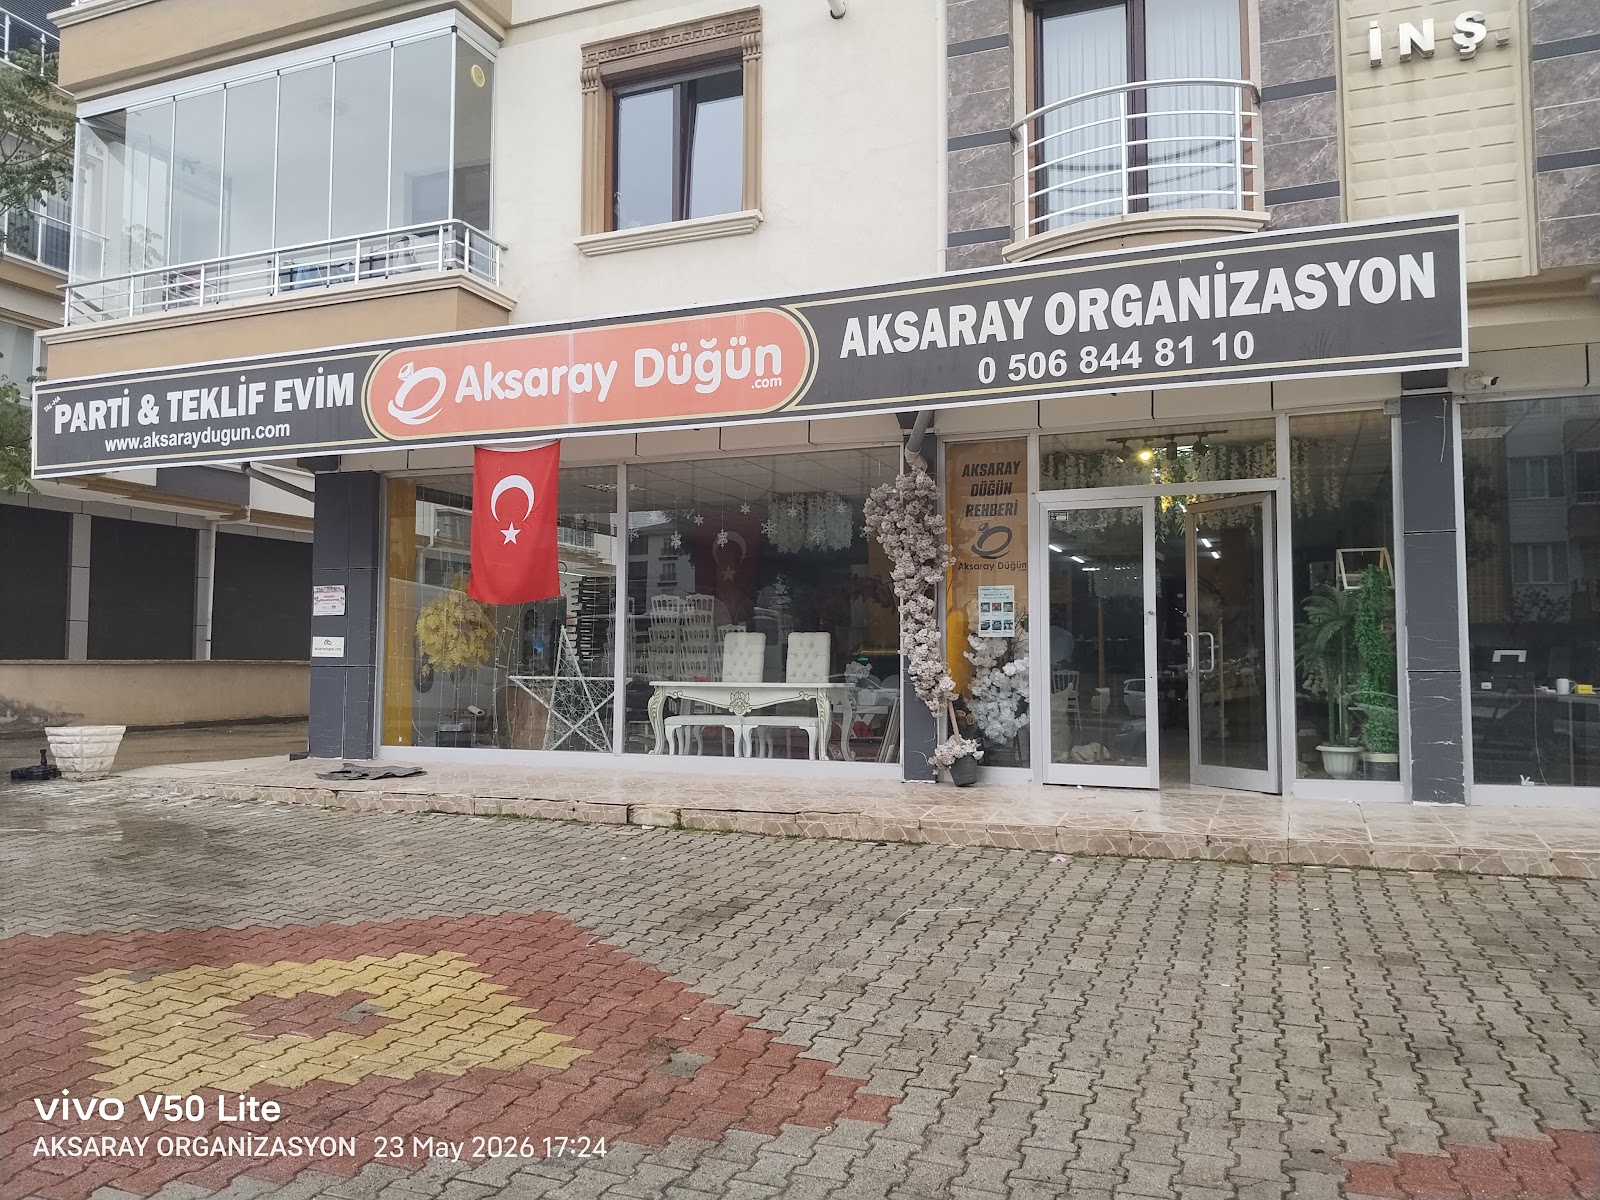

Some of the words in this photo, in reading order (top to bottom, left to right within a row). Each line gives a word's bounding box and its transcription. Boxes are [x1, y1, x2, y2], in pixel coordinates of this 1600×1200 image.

[839, 296, 1033, 359] AKSARAY
[1044, 251, 1436, 336] ORGANİZASYON
[978, 355, 996, 385] 0
[1007, 349, 1068, 382] 506
[1079, 341, 1143, 373] 844
[1155, 336, 1193, 367] 81
[1211, 330, 1255, 362] 10
[455, 361, 618, 404] Aksaray
[634, 336, 783, 394] Düğün
[751, 375, 783, 390] .com
[54, 388, 130, 434] PARTİ
[137, 393, 160, 425] &
[167, 375, 267, 422] TEKLİF
[274, 366, 354, 412] EVİM
[105, 421, 291, 452] www.aksaraydugun.com
[962, 461, 1020, 477] AKSARAY
[970, 480, 1012, 496] DÜĞÜN
[965, 500, 1019, 517] REHBERİ
[958, 562, 995, 572] Aksaray
[998, 561, 1027, 572] Düğün
